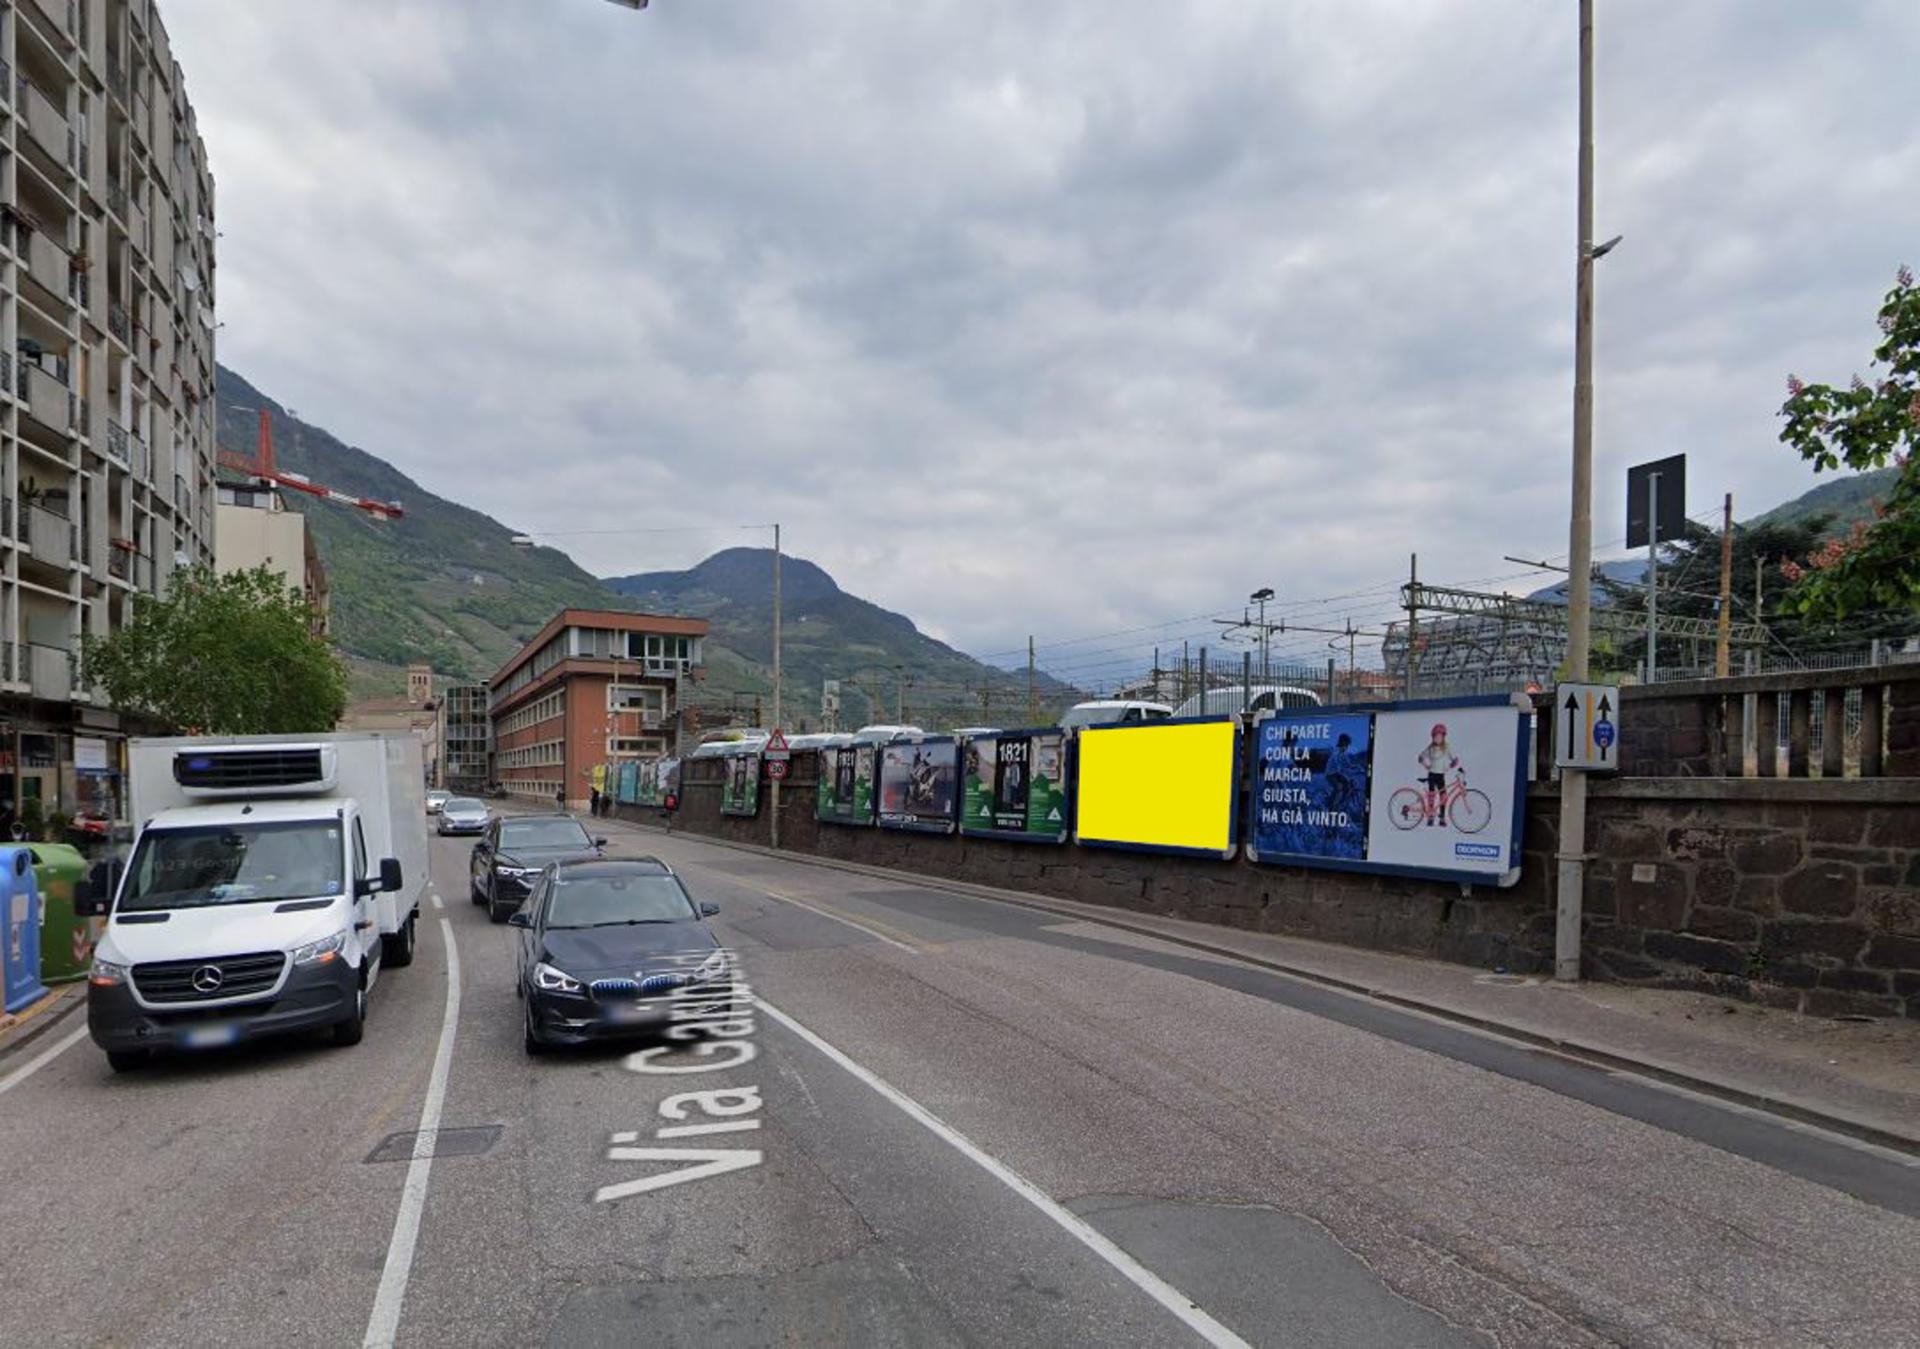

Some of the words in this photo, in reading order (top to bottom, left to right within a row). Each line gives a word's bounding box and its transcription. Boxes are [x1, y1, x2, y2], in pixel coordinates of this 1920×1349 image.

[1266, 726, 1287, 740] CHI
[1291, 723, 1331, 739] PARTE
[1265, 747, 1291, 760] CON
[1294, 747, 1310, 760] LA
[1264, 767, 1312, 781] MARCIA
[1263, 788, 1311, 806] GIUSTA,
[1262, 808, 1278, 823] HA
[1281, 806, 1303, 824] GIÀ
[1307, 811, 1350, 827] VINTO.
